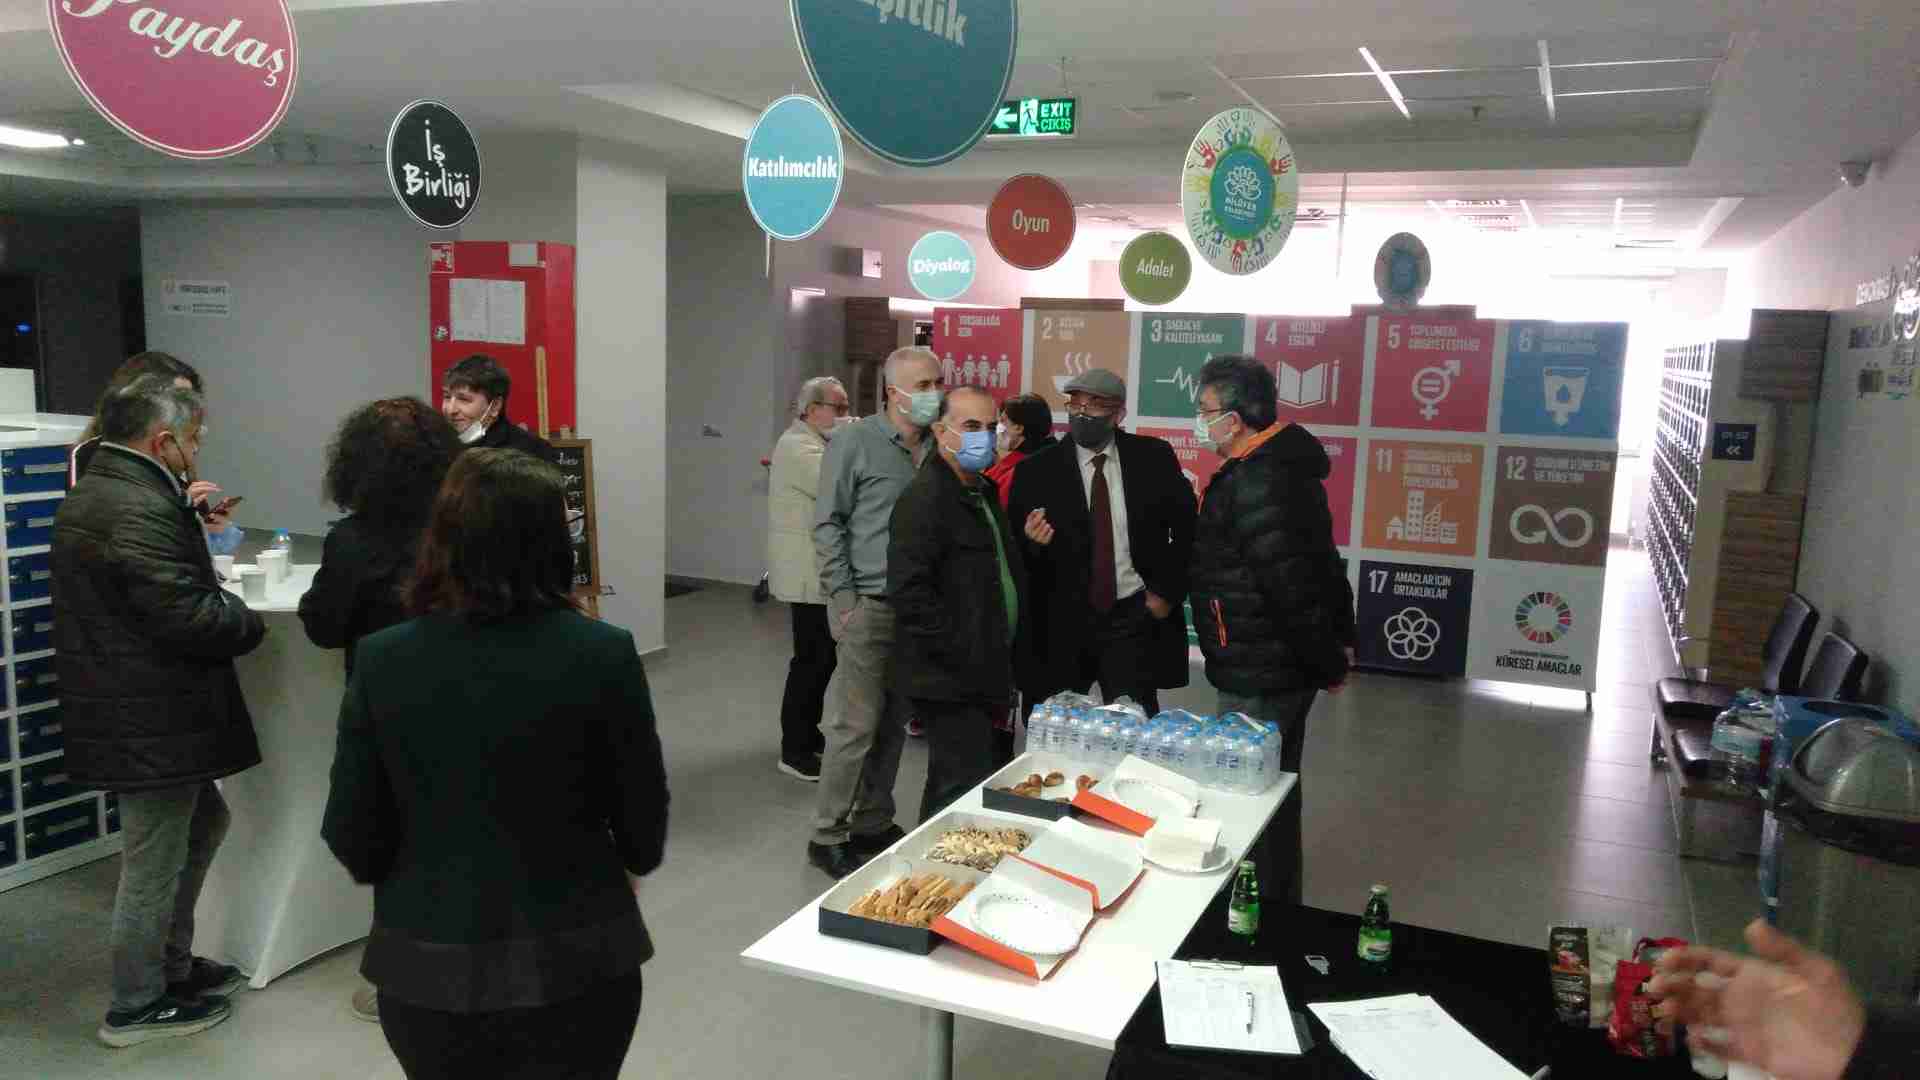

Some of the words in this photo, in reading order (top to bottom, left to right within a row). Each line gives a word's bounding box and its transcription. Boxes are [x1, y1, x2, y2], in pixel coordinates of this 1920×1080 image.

[1041, 102, 1073, 118] EXIT
[425, 119, 446, 168] İş
[748, 155, 837, 178] Katılımcılık
[402, 162, 471, 208] Birliği
[1012, 208, 1050, 235] Oyun
[1136, 258, 1174, 278] Adalet
[942, 314, 950, 337] 1
[1043, 316, 1053, 340] 2
[1151, 319, 1163, 343] 3
[1265, 320, 1278, 344] 4
[1387, 324, 1401, 349] 5
[1377, 448, 1393, 473] 11
[1505, 455, 1528, 481] 12
[1369, 569, 1389, 593] 17
[1496, 655, 1535, 671] KÜRESEL
